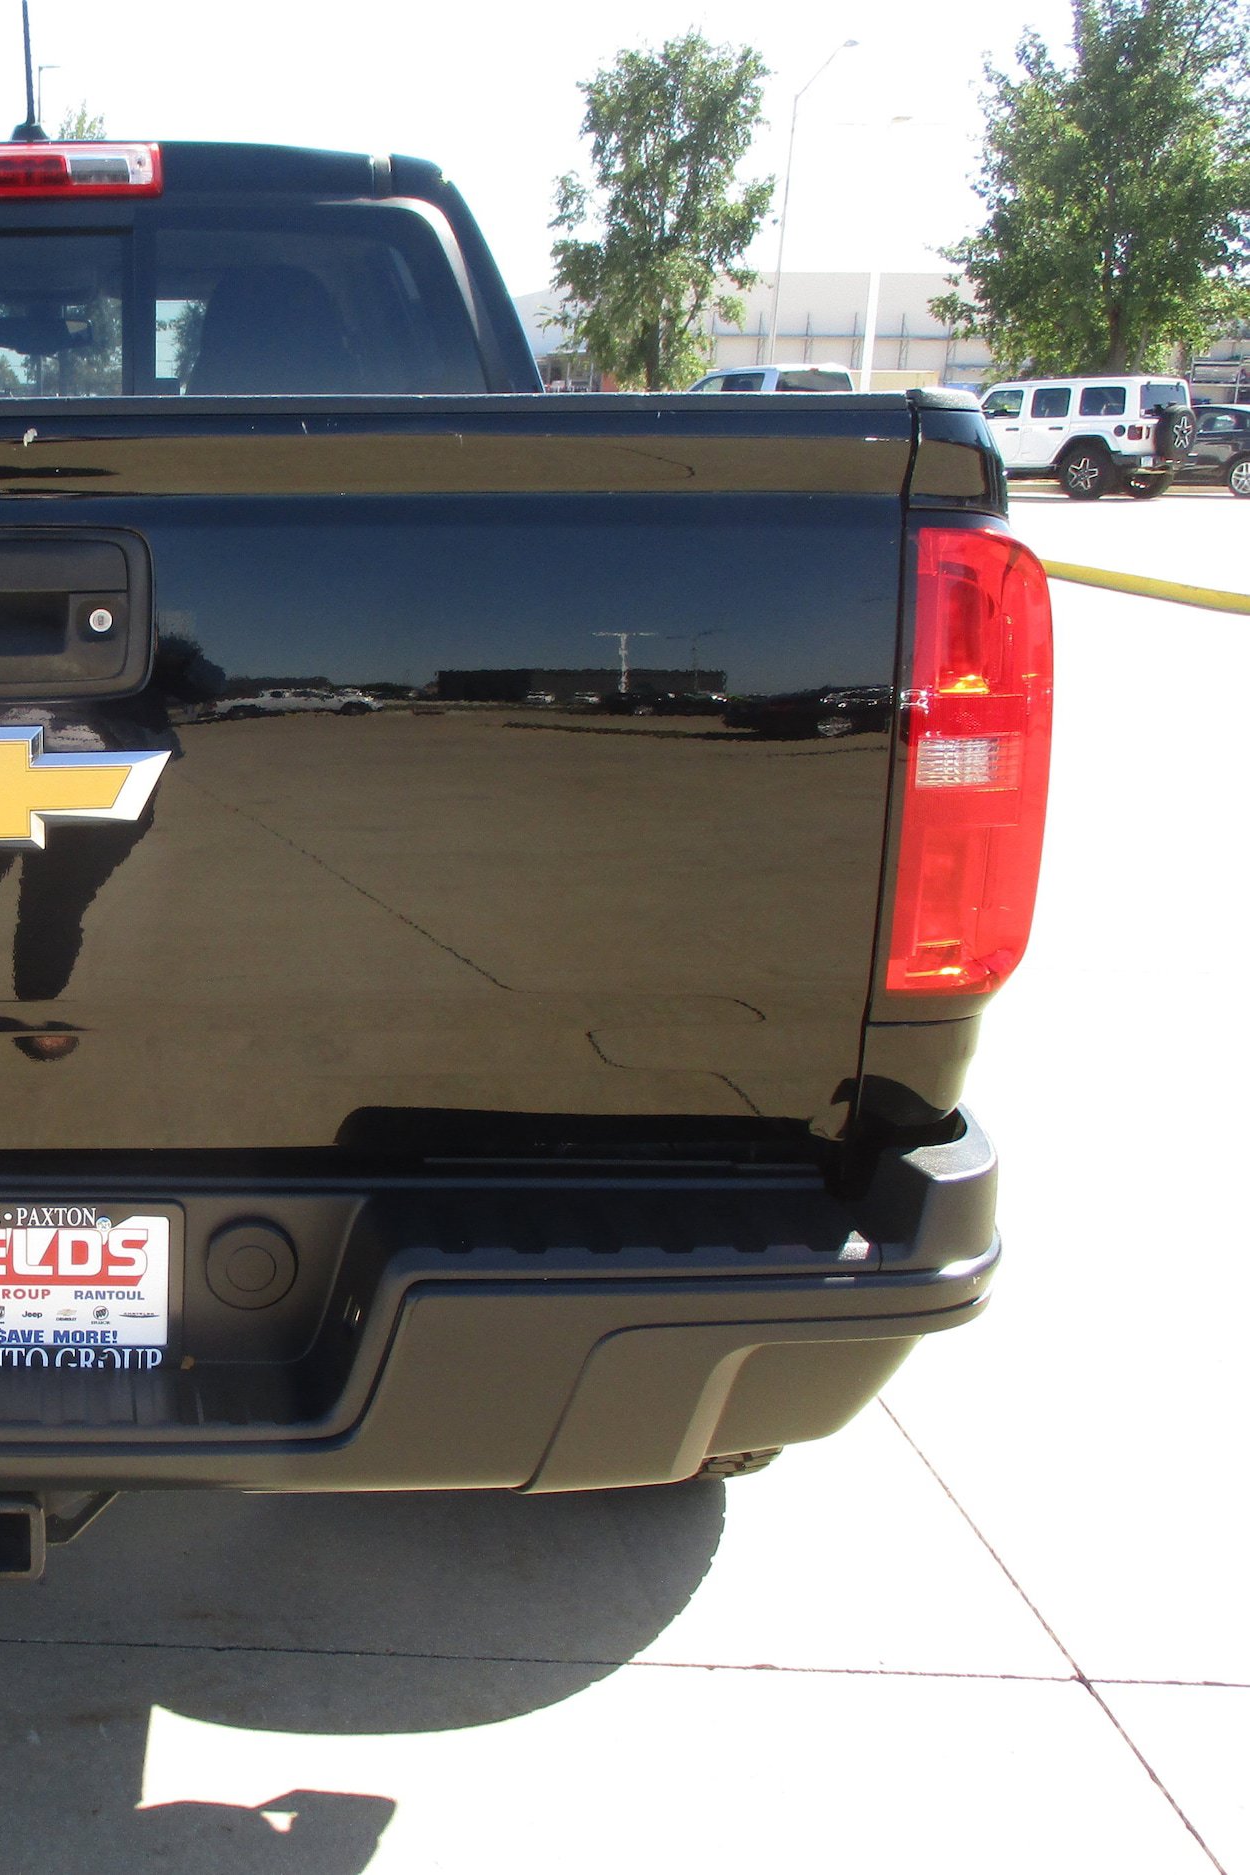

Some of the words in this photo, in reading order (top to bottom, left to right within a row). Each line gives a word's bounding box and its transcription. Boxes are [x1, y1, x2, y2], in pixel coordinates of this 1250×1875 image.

[17, 1207, 96, 1227] PAXTON
[74, 1290, 145, 1301] RANTOUL
[22, 1310, 43, 1319] Jeep
[53, 1330, 118, 1344] MORE!
